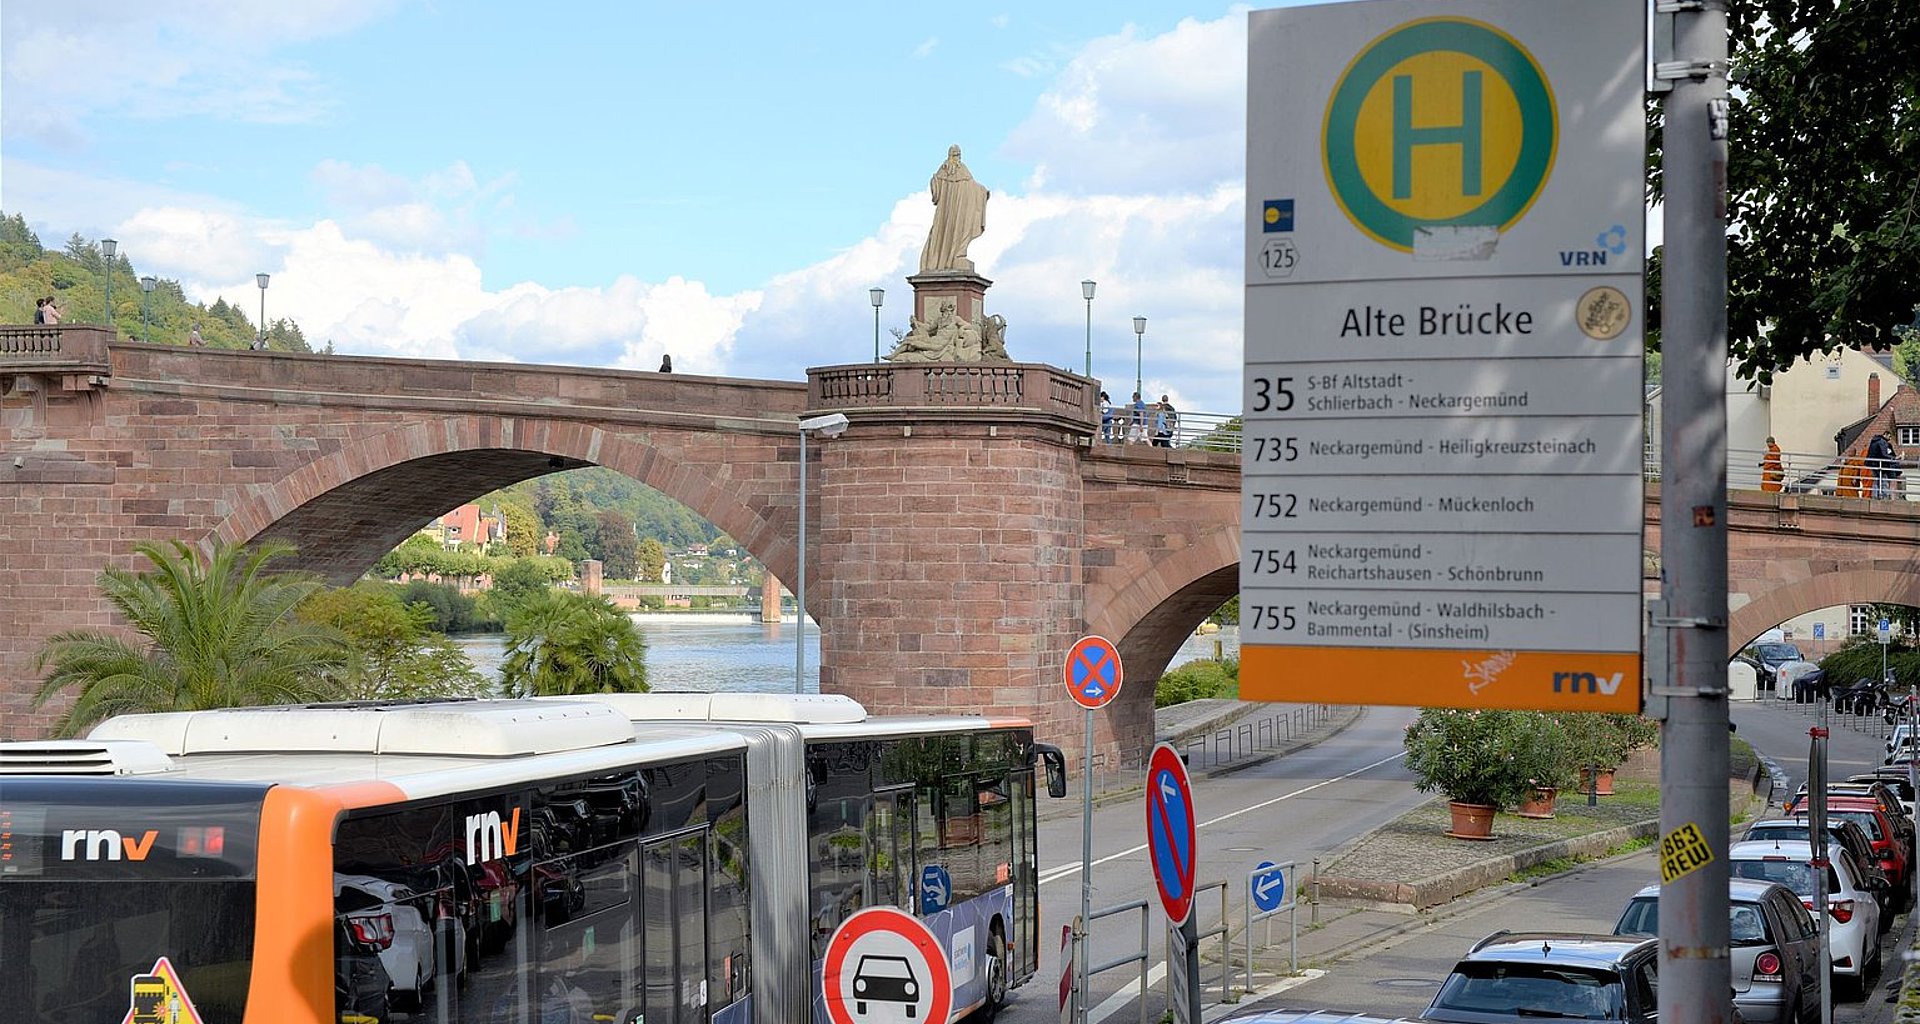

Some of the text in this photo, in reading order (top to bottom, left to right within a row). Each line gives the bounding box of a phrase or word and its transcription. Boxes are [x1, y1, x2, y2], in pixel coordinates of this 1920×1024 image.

[1393, 70, 1482, 199] H
[1263, 248, 1295, 269] 125
[1559, 250, 1607, 267] VRN
[1340, 303, 1534, 338] Alte Brücke
[1307, 374, 1338, 391] S-Bf
[1342, 373, 1403, 390] Altstadt
[1252, 377, 1295, 412] 35
[1307, 394, 1393, 412] Schlierbach
[1409, 391, 1528, 412] Neckargemünd
[1252, 437, 1299, 462] 735
[1309, 439, 1423, 460] Neckargemünd
[1439, 437, 1596, 459] Heiligkreuzsteinach
[1252, 494, 1298, 518] 752
[1308, 496, 1423, 517] Neckargemünd
[1438, 496, 1534, 513] Mückenloch
[1250, 550, 1298, 575] 754
[1308, 543, 1422, 564] Neckargemünd
[1307, 565, 1432, 581] Reichartshausen
[1447, 565, 1544, 582] Schönbrunn
[1250, 605, 1296, 631] 755
[1307, 601, 1421, 621] Neckargemünd
[1437, 602, 1544, 619] Waldhilsbach
[1307, 622, 1392, 638] Bammental
[1408, 623, 1489, 642] (Sinsheim)
[1553, 672, 1623, 695] rnv
[61, 829, 159, 861] rnv
[465, 807, 520, 866] rnv
[1661, 825, 1699, 859] 863
